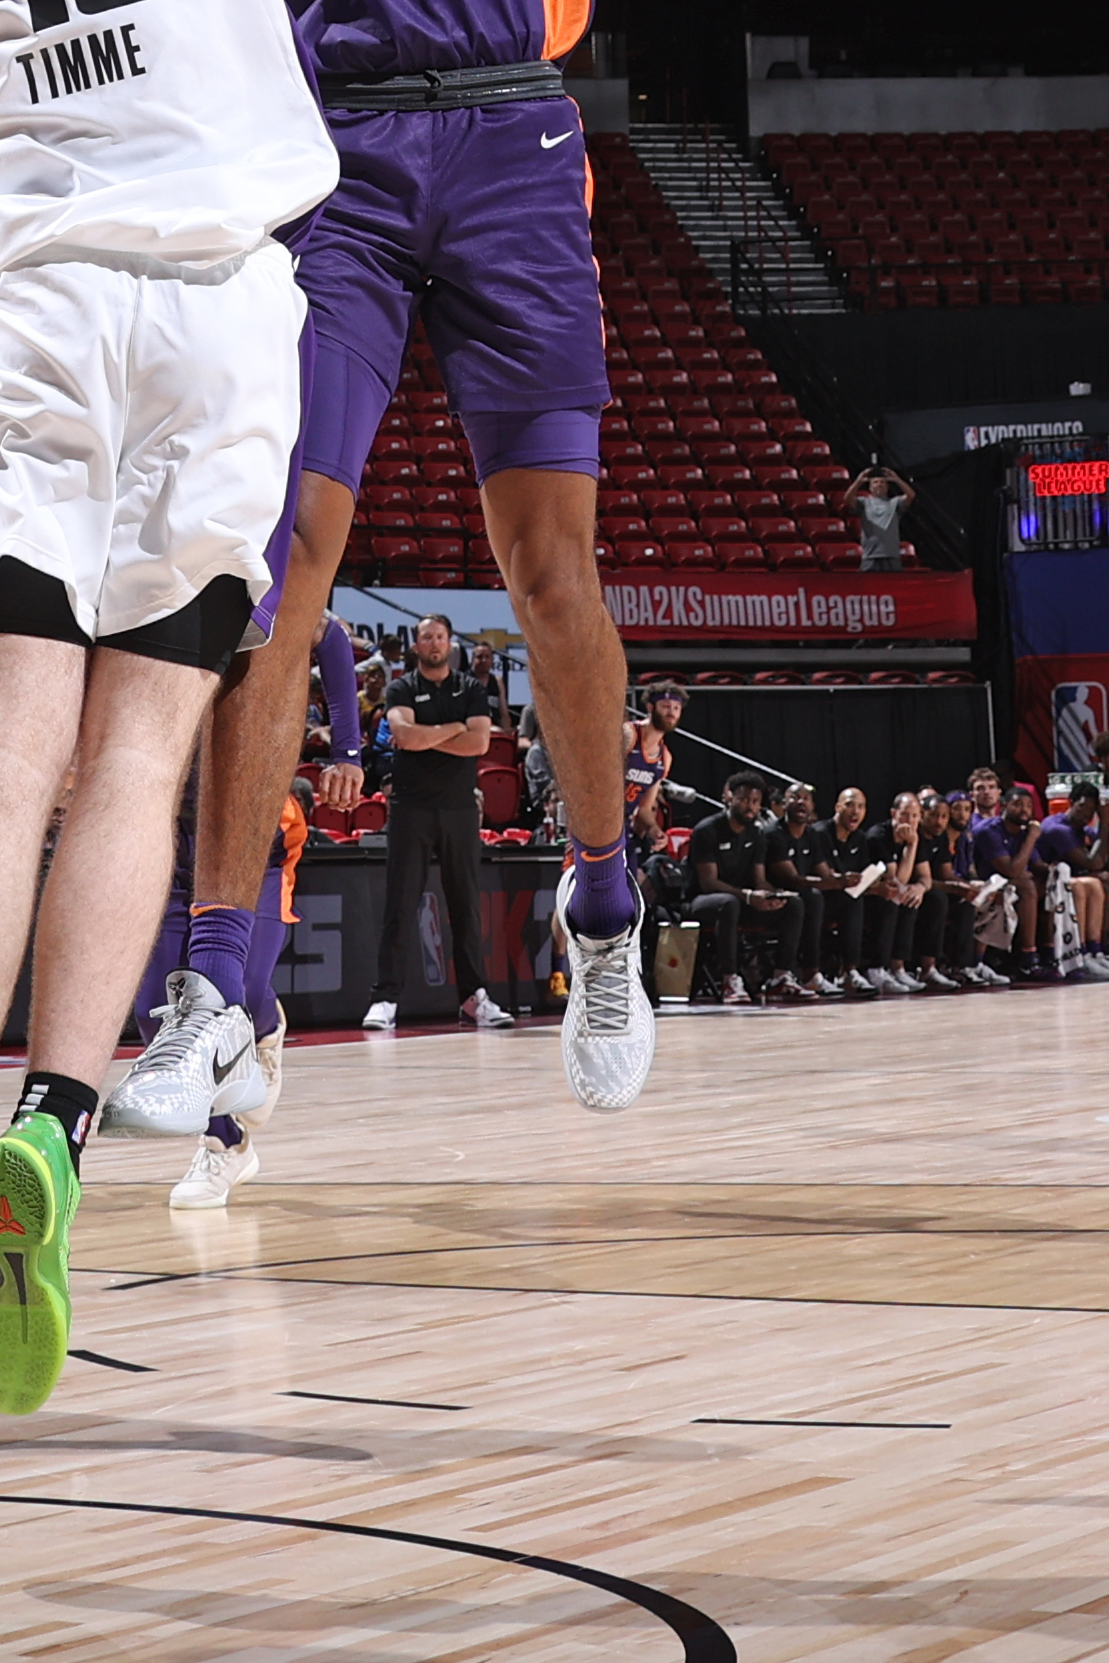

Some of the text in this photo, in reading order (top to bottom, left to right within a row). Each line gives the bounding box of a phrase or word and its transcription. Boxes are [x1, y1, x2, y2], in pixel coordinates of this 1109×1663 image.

[15, 22, 147, 106] TIMME
[1029, 462, 1109, 481] SUMMER
[1036, 478, 1107, 496] LEAGUE
